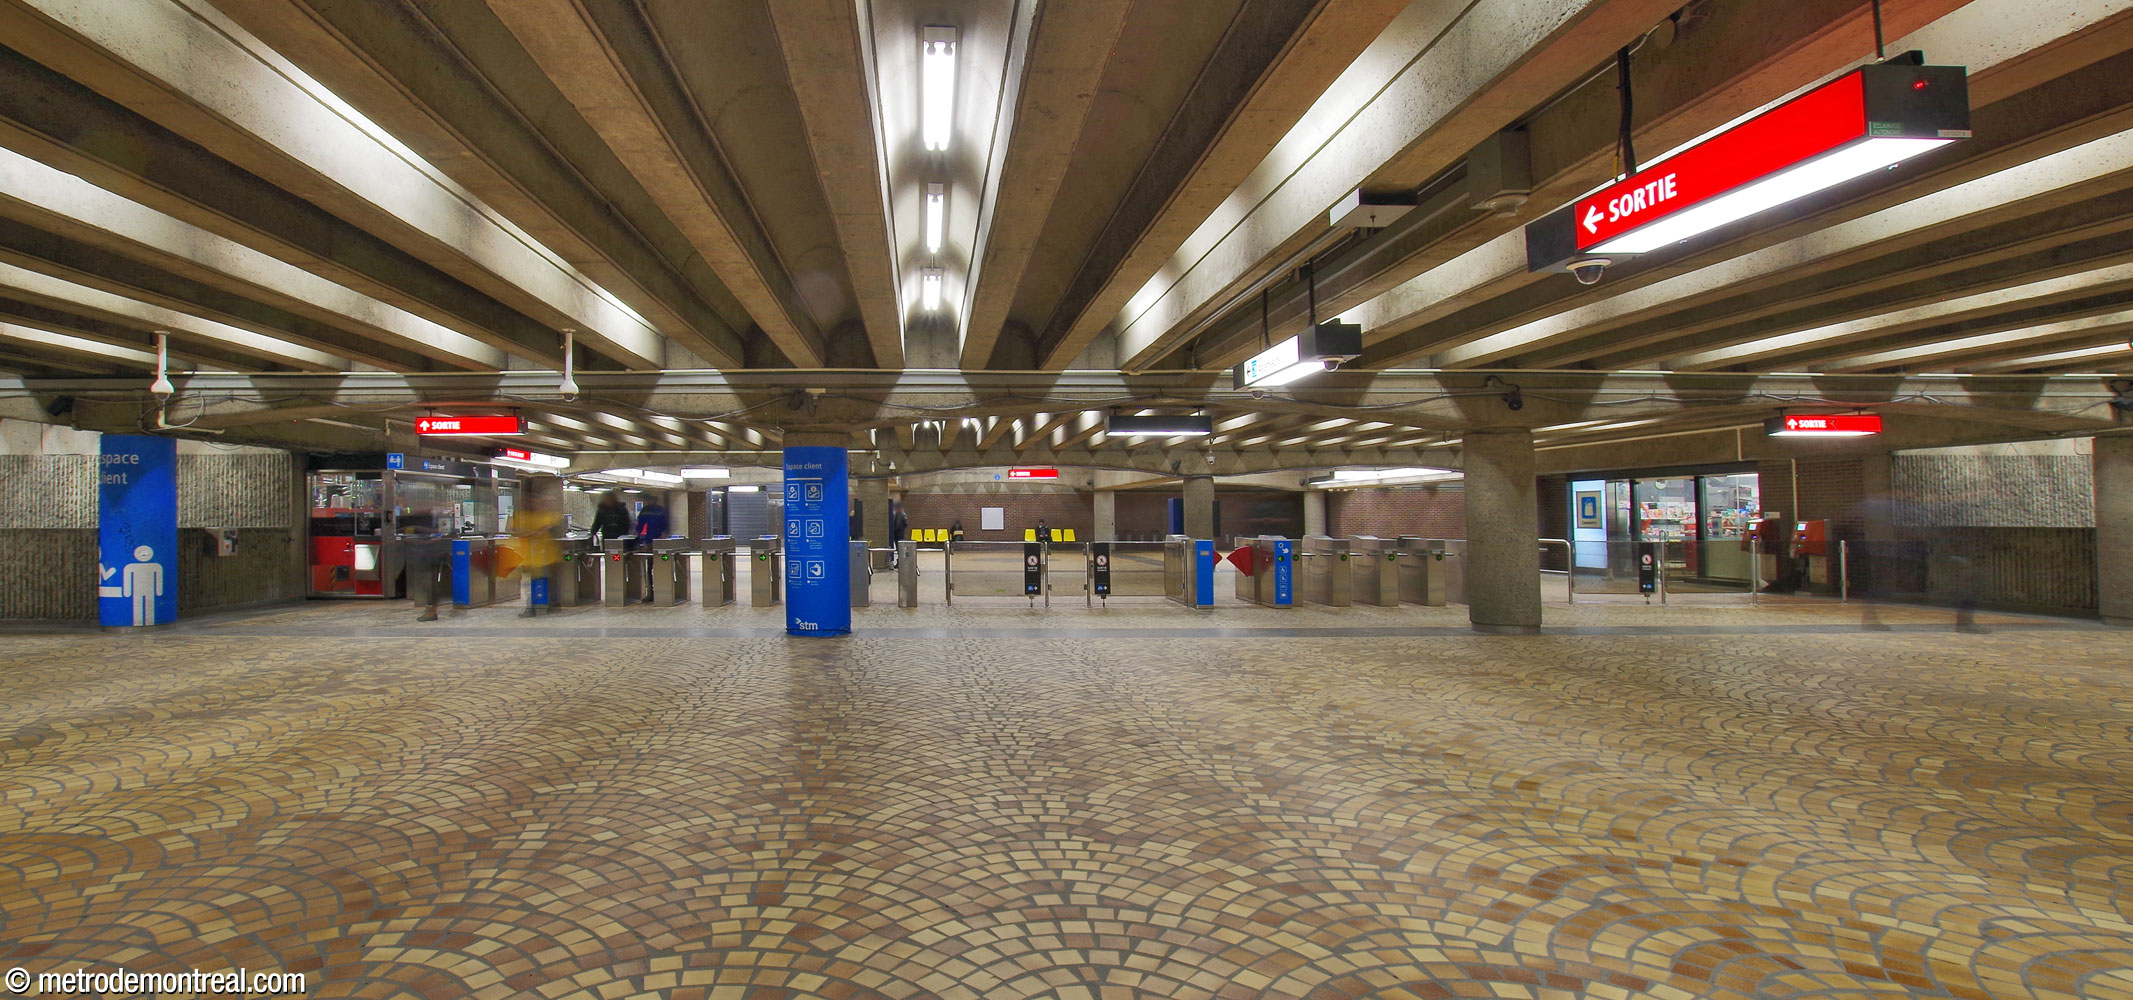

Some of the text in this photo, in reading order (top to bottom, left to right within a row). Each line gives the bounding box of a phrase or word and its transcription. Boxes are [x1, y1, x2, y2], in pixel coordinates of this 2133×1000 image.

[1608, 172, 1678, 223] SORTIE
[431, 421, 460, 429] SORTIE
[1798, 420, 1826, 428] SORTIE
[799, 621, 819, 631] stm
